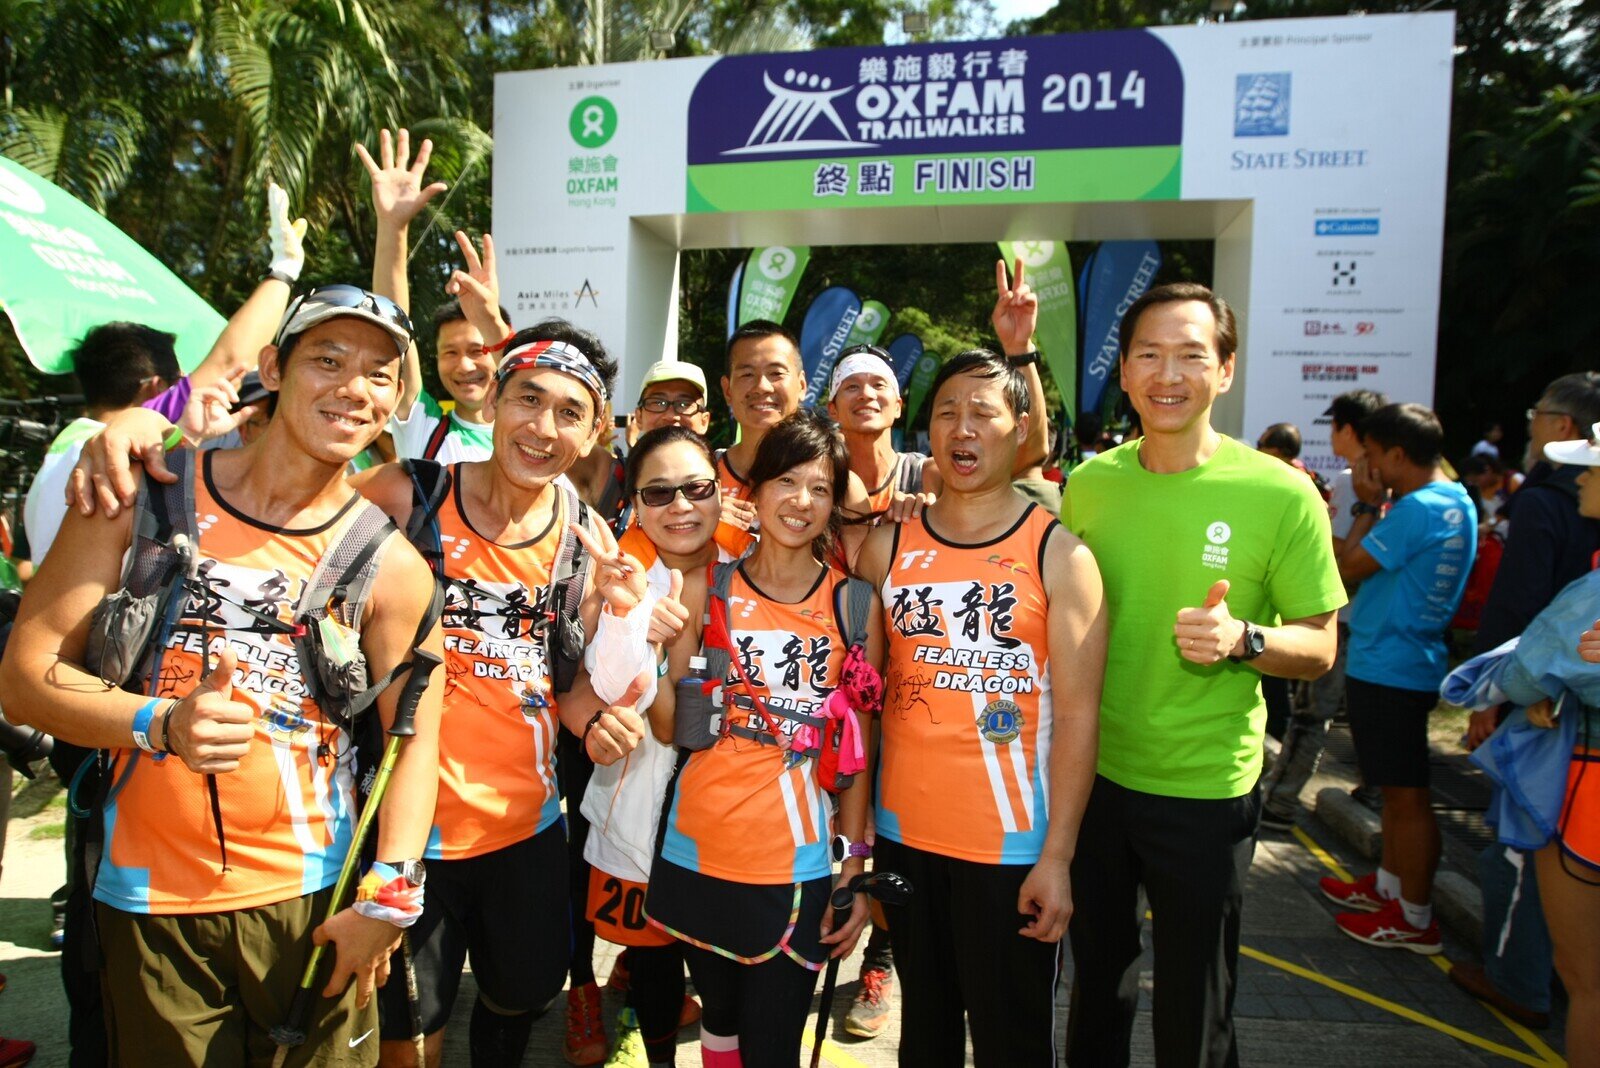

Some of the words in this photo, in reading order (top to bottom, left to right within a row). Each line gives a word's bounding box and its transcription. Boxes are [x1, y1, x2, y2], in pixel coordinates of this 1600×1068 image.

[1287, 34, 1328, 46] Principal
[1332, 33, 1372, 44] Sponsor
[859, 49, 1028, 83] 樂施毅行者
[856, 79, 1025, 120] OXFAM
[1041, 70, 1145, 112] 2014
[857, 115, 1025, 141] TRAILWALKER
[568, 154, 618, 173] 樂施會
[1231, 151, 1289, 170] STATE
[1294, 149, 1368, 168] STREET
[566, 177, 618, 195] OXFAM
[813, 161, 894, 196] 終點
[914, 157, 1035, 194] FINISH
[568, 198, 592, 208] Hong
[593, 197, 616, 207] Kong
[1328, 222, 1378, 233] Columbia
[518, 291, 540, 299] Asia
[543, 290, 569, 299] Miles
[1089, 319, 1122, 379] STATE
[1116, 251, 1159, 318] STREET
[804, 358, 831, 403] STATE
[823, 305, 859, 359] STREET
[1201, 553, 1229, 565] OXFAM
[892, 581, 1022, 650] 猛龍
[913, 645, 1030, 671] FEARLESS
[933, 671, 1033, 694] DRAGON
